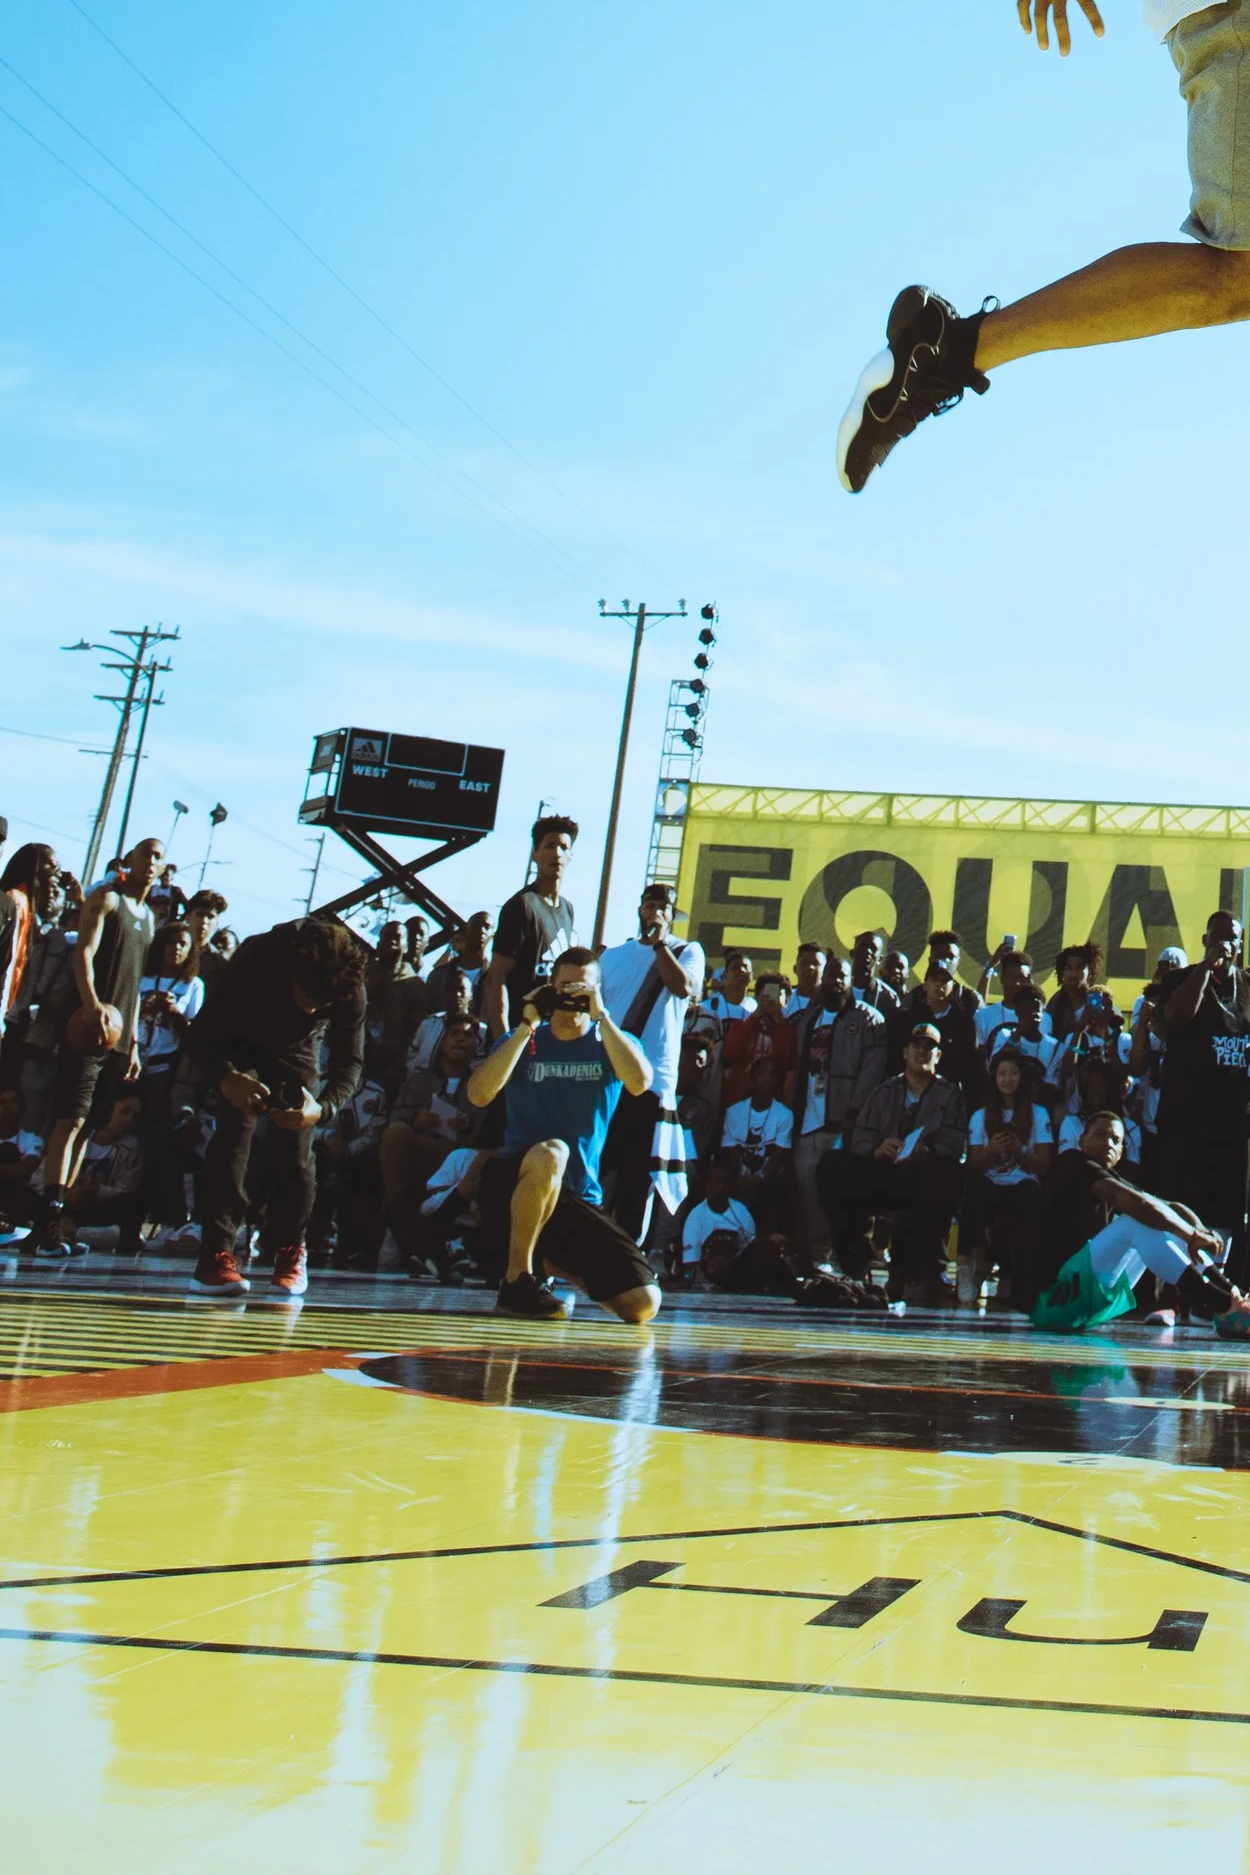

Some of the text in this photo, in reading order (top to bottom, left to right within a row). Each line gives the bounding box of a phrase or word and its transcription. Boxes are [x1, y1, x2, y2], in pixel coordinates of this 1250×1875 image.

[352, 764, 388, 778] WEST
[459, 780, 490, 793] EAST
[536, 1559, 1209, 1652] Hu
